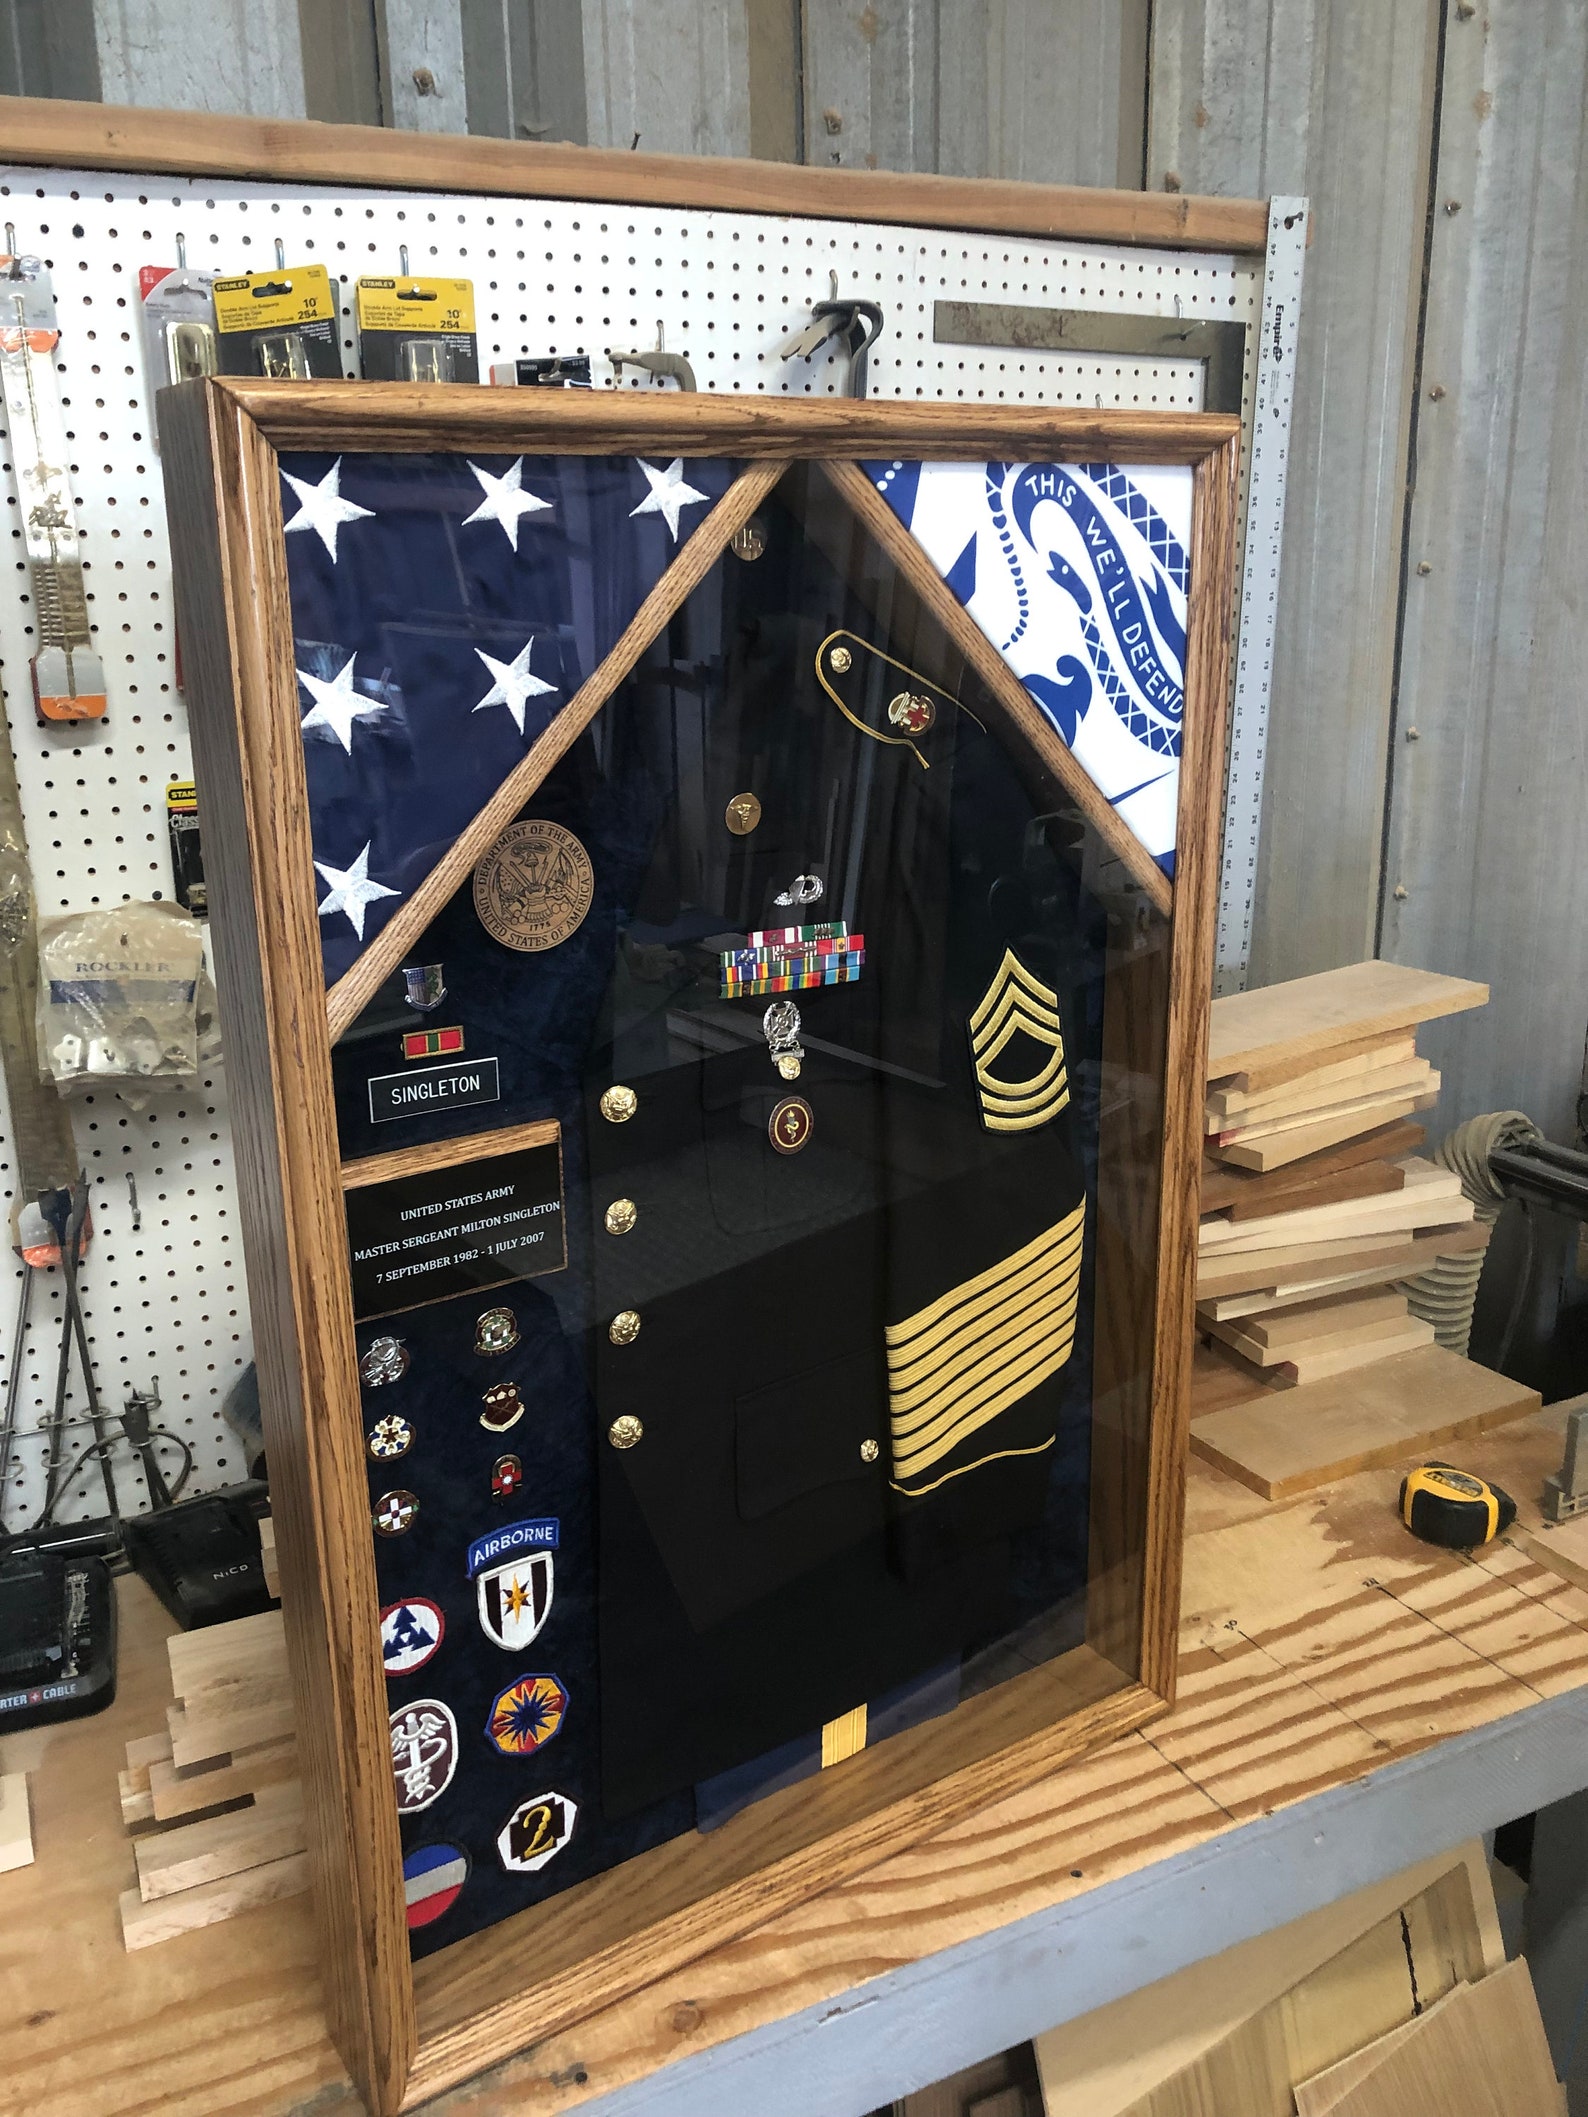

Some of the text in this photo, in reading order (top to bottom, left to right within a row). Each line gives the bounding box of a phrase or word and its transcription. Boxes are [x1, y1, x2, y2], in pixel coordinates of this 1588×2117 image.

[216, 281, 248, 291] STANLEY
[362, 280, 393, 288] STANLEY
[297, 309, 318, 320] 254
[440, 320, 460, 329] 254
[1272, 304, 1285, 358] Empire
[1024, 473, 1183, 714] THIS WE'LL DEFEND
[171, 790, 197, 799] STAN
[478, 825, 587, 885] DEPARTMENT OF THE ARMY
[478, 878, 590, 947] UNITED STATES OF AMERICA
[529, 922, 551, 931] 1775
[391, 1074, 481, 1106] SINGLETON
[400, 1184, 516, 1221] UNITED STATES ARMY
[354, 1200, 561, 1261] MASTER SERGEANT MILTON SINGLETON
[376, 1273, 384, 1284] 7
[385, 1257, 452, 1282] SEPTEMBER
[453, 1249, 479, 1264] 1982
[487, 1246, 494, 1256] 1
[495, 1237, 519, 1255] JULY
[520, 1231, 546, 1247] 2007
[473, 1525, 555, 1567] AIRBORNE
[0, 1684, 77, 1709] RTER CABLE
[523, 1804, 554, 1858] 2
